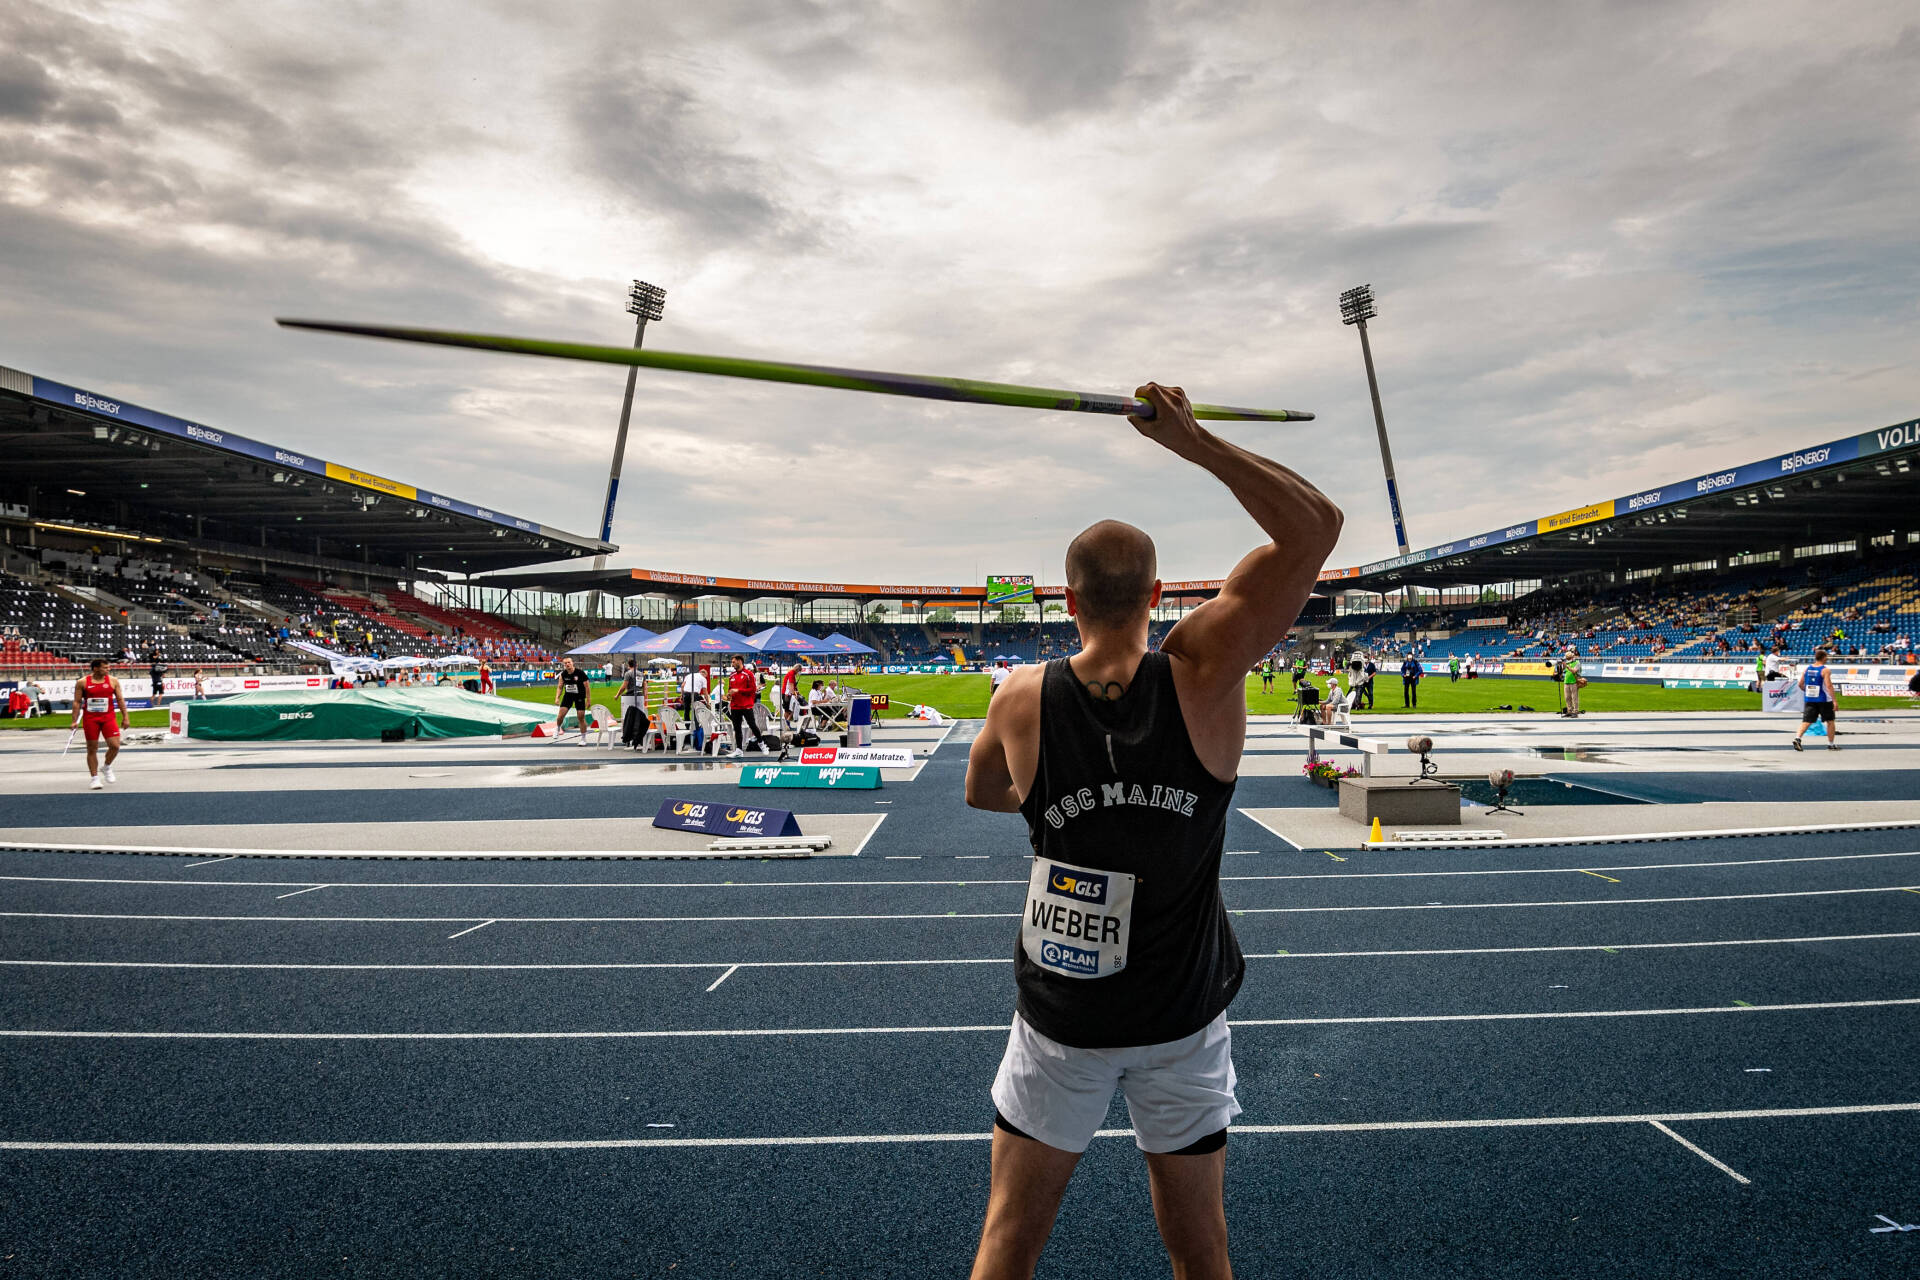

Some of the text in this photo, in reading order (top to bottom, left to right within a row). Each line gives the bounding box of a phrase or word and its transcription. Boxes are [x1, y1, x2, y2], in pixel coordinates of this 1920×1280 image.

[1548, 508, 1600, 528] Wir sind Eintracht.
[1406, 552, 1426, 562] SERVICES
[650, 572, 704, 584] Volksbank BraWo
[748, 580, 774, 590] EINMAL
[798, 584, 824, 592] IMMER
[880, 586, 948, 594] Volksbank BraWo
[280, 712, 312, 720] BENZ
[804, 752, 834, 760] bett1.de
[838, 752, 850, 760] Wir
[852, 752, 868, 760] sind
[689, 804, 708, 818] GLS
[1045, 782, 1198, 828] USC MAINZ
[744, 811, 765, 824] GLS
[1075, 880, 1102, 898] GLS
[1032, 899, 1120, 944] WEBER
[1062, 950, 1096, 967] PLAN
